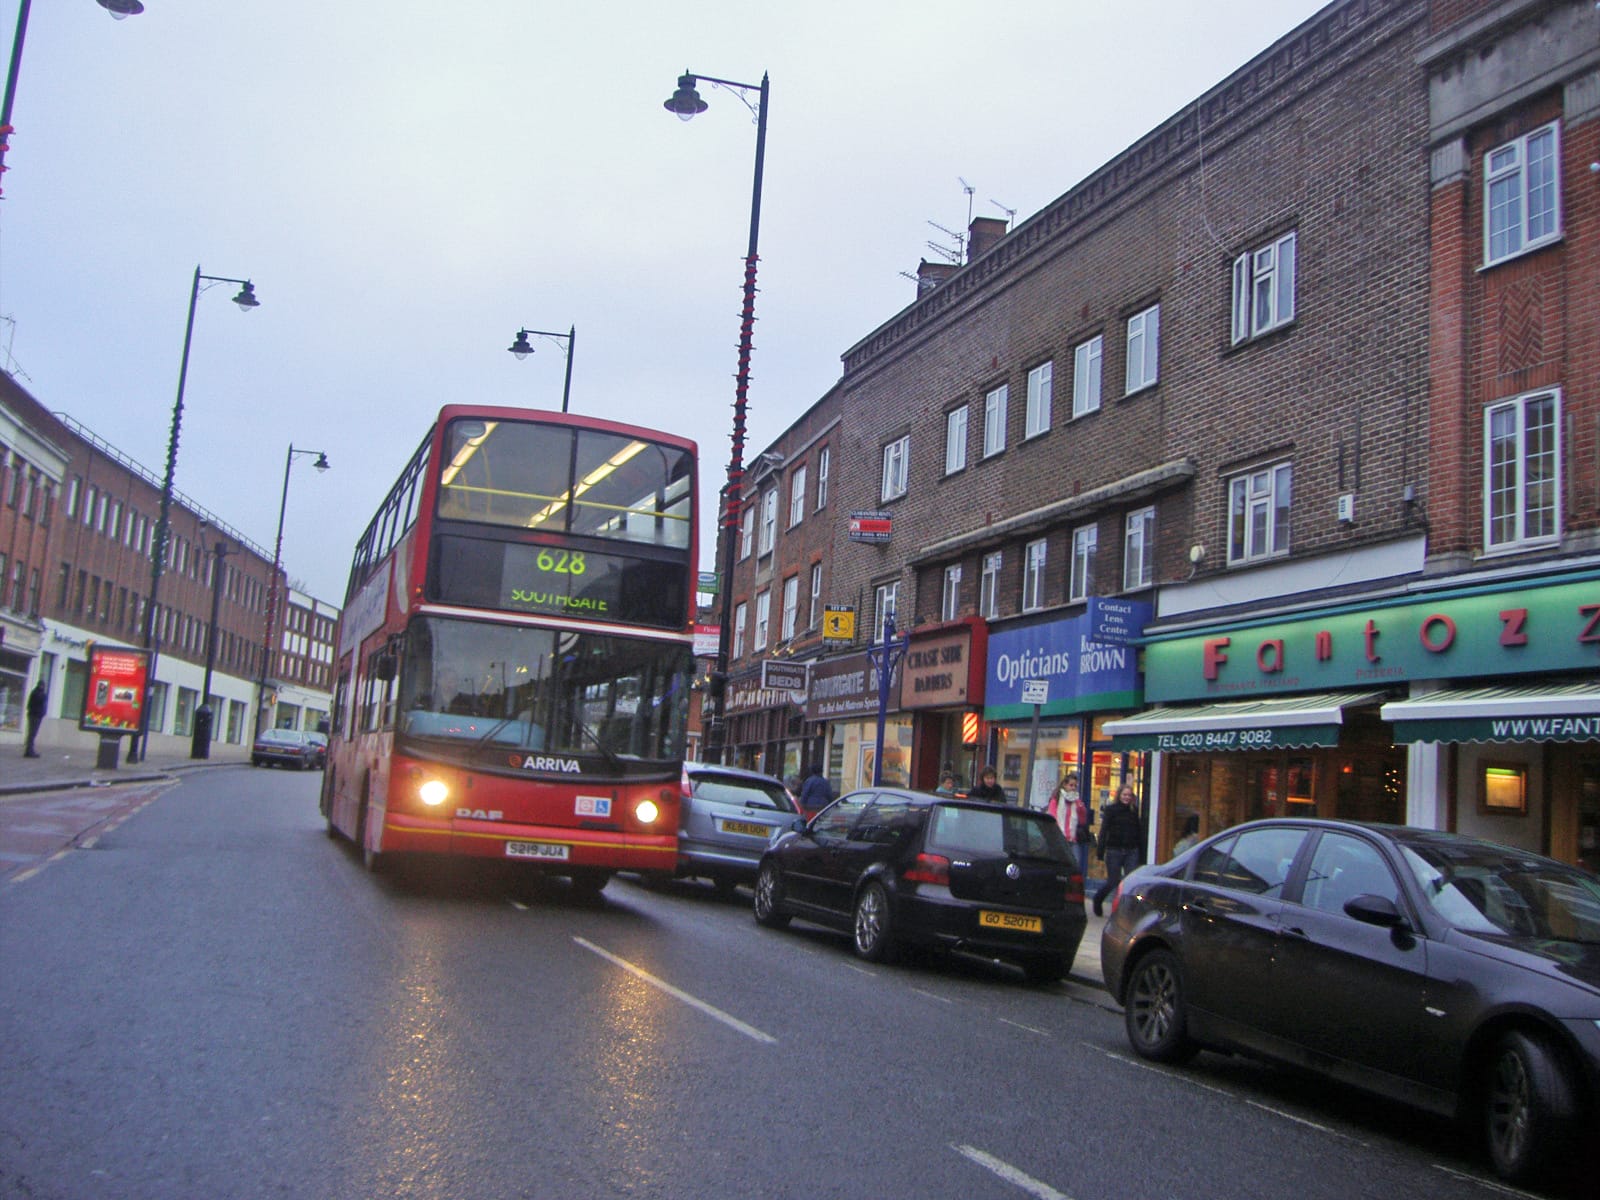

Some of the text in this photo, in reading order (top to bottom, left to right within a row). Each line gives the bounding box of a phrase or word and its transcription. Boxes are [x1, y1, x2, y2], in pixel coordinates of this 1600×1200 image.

[536, 547, 586, 575] 628
[511, 588, 608, 611] SOUTHGATE
[1097, 601, 1132, 614] Contact
[1104, 613, 1124, 624] Lens
[1099, 624, 1129, 636] Centre
[908, 648, 939, 670] CHASE
[996, 647, 1070, 689] Opticians
[1080, 648, 1126, 674] BROWN
[768, 674, 803, 690] BEDS
[812, 670, 865, 701] SOUTHGATE
[914, 672, 954, 694] BARBERS
[1205, 732, 1236, 745] 8447
[1239, 730, 1272, 744] 9082
[523, 755, 581, 773] ARRIVA
[455, 807, 503, 820] DAF
[509, 844, 564, 858] S219 JUA
